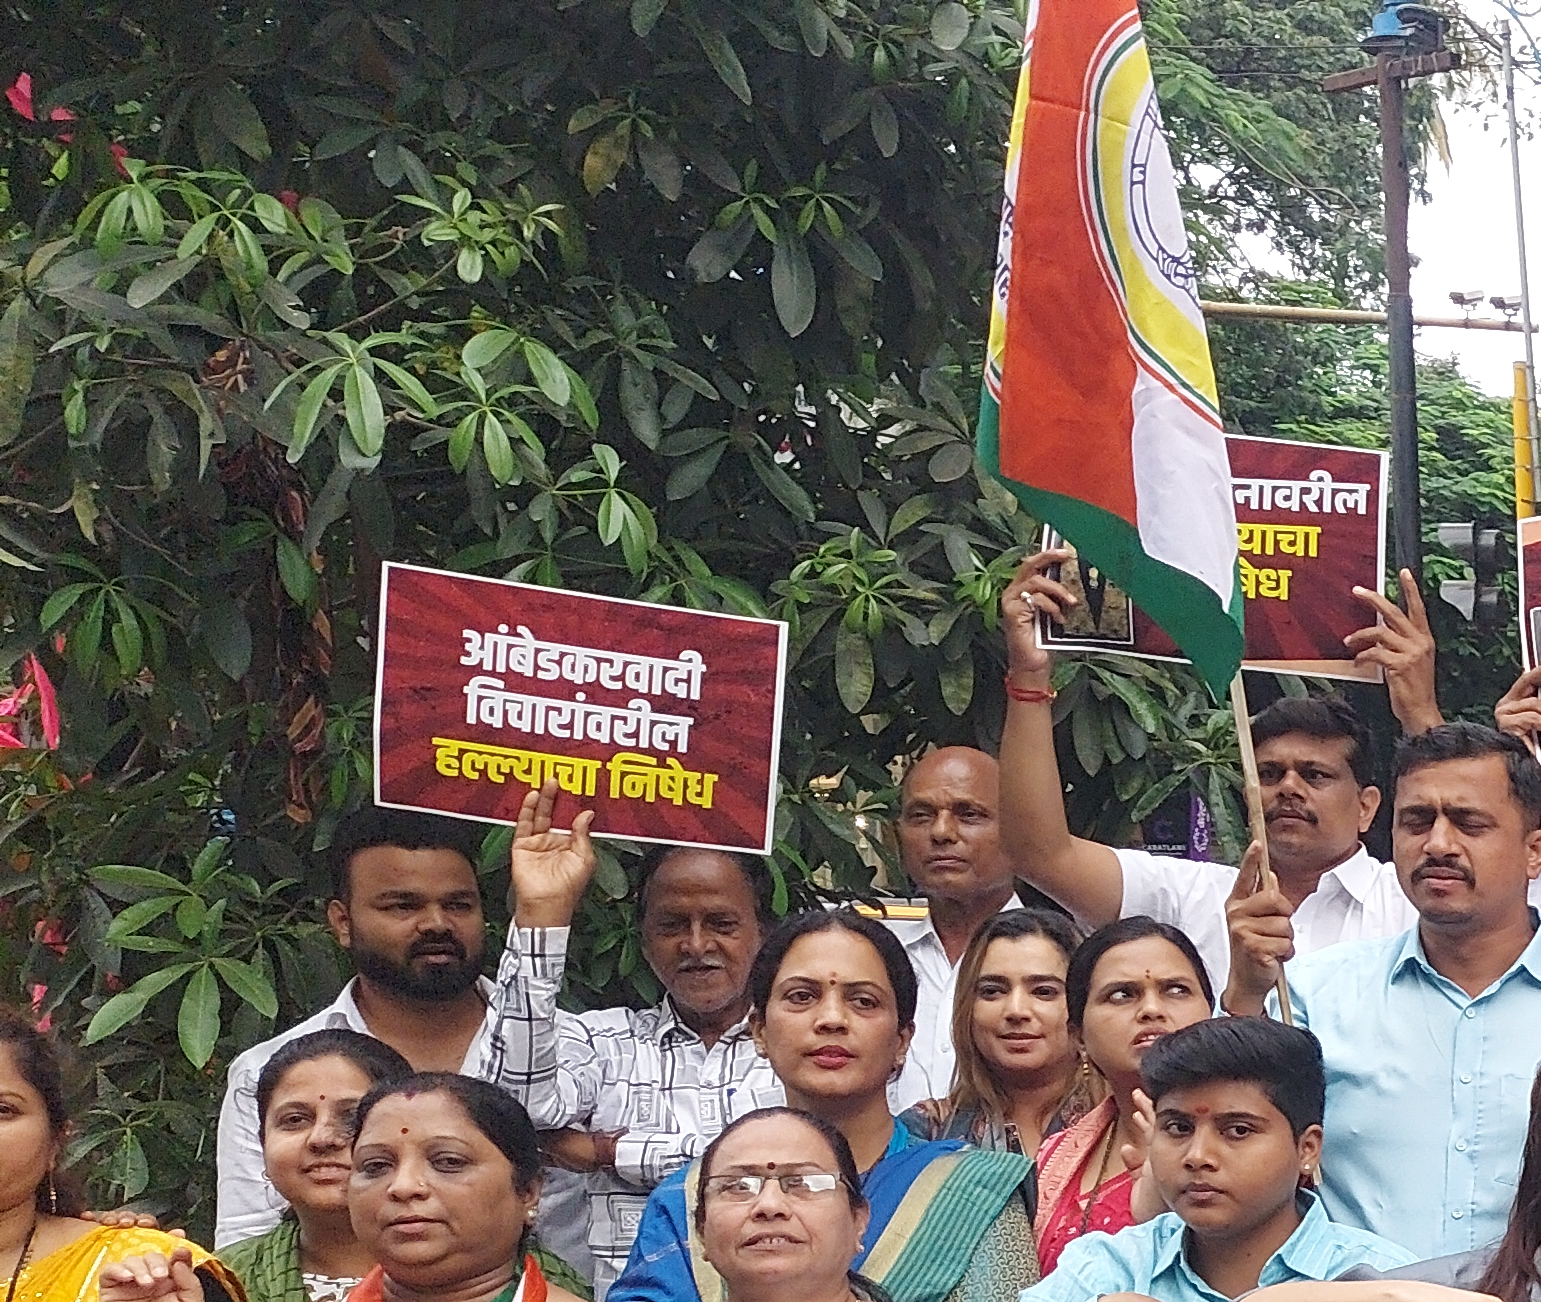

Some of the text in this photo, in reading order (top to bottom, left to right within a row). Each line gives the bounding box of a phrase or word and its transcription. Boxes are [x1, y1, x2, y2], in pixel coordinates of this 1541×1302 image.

[460, 623, 707, 700] आंबेडकरवादी
[463, 677, 695, 754] विचारांवरील
[432, 737, 718, 809] हल्ल्याचा निषेध
